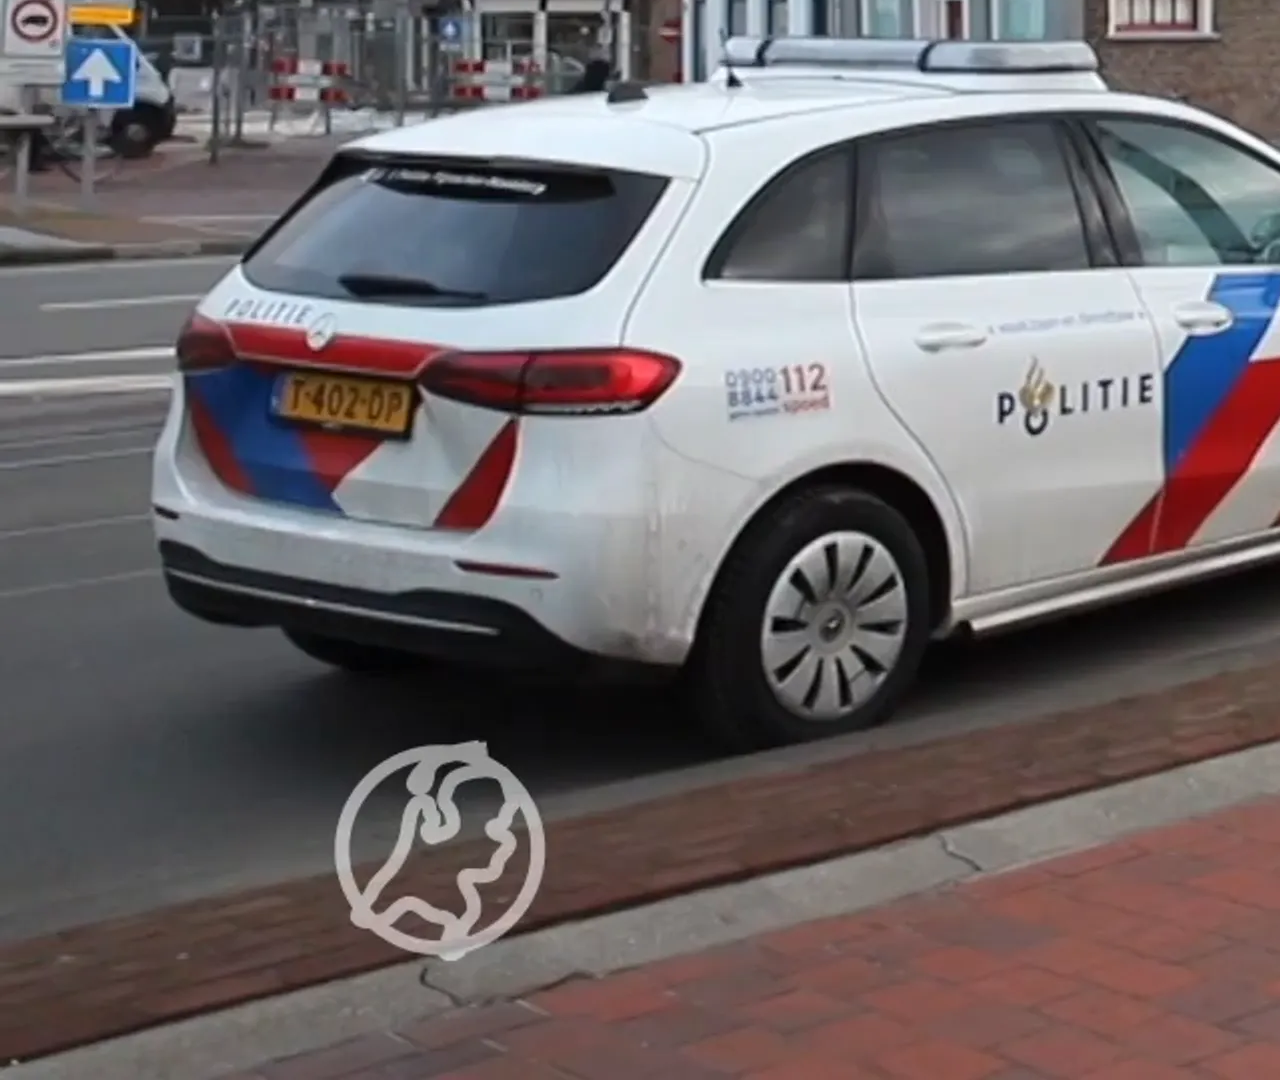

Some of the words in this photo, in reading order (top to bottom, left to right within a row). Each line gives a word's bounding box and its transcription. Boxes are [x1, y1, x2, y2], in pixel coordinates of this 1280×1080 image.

[224, 297, 314, 324] POLITIE
[725, 367, 777, 388] 0900
[780, 362, 827, 393] 112
[727, 387, 779, 408] 8844
[997, 373, 1154, 436] POLITIE
